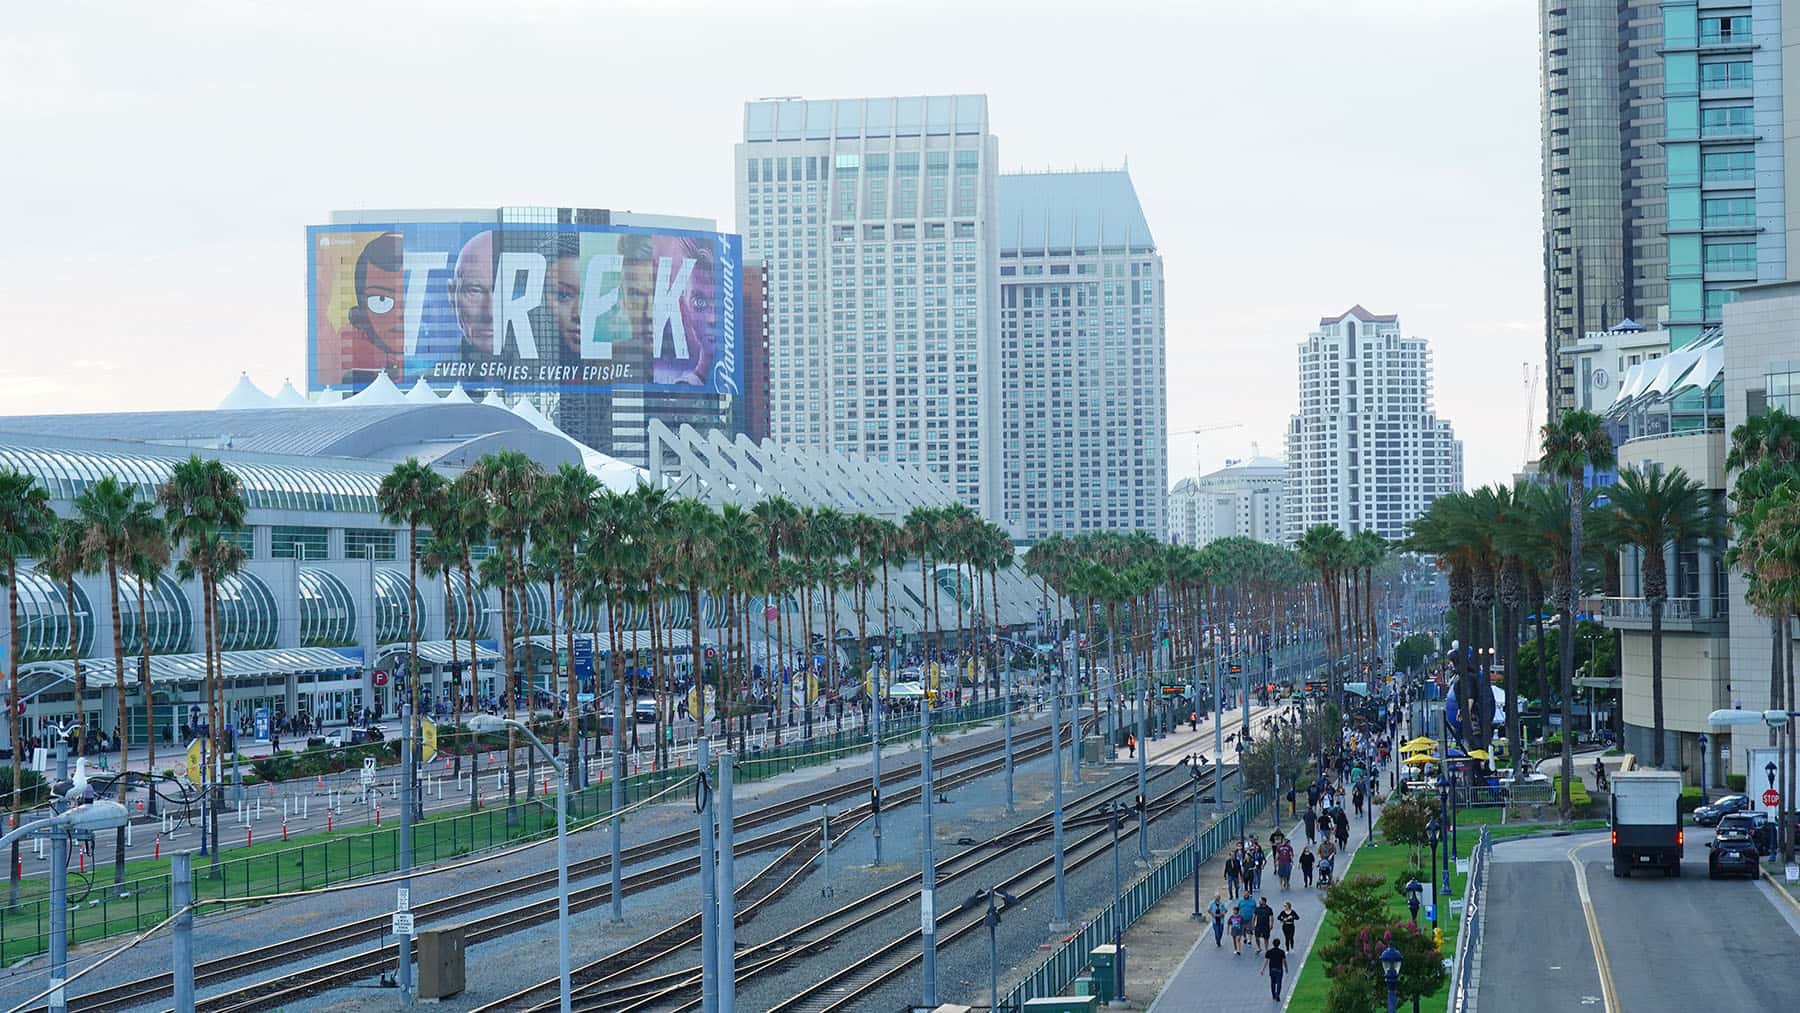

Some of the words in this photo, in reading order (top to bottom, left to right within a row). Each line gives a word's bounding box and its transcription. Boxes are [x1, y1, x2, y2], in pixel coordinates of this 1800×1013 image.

[403, 251, 697, 360] TREK
[433, 362, 475, 377] EVERY
[479, 362, 532, 380] SERIES.
[539, 365, 578, 380] EVERY
[376, 674, 383, 684] F
